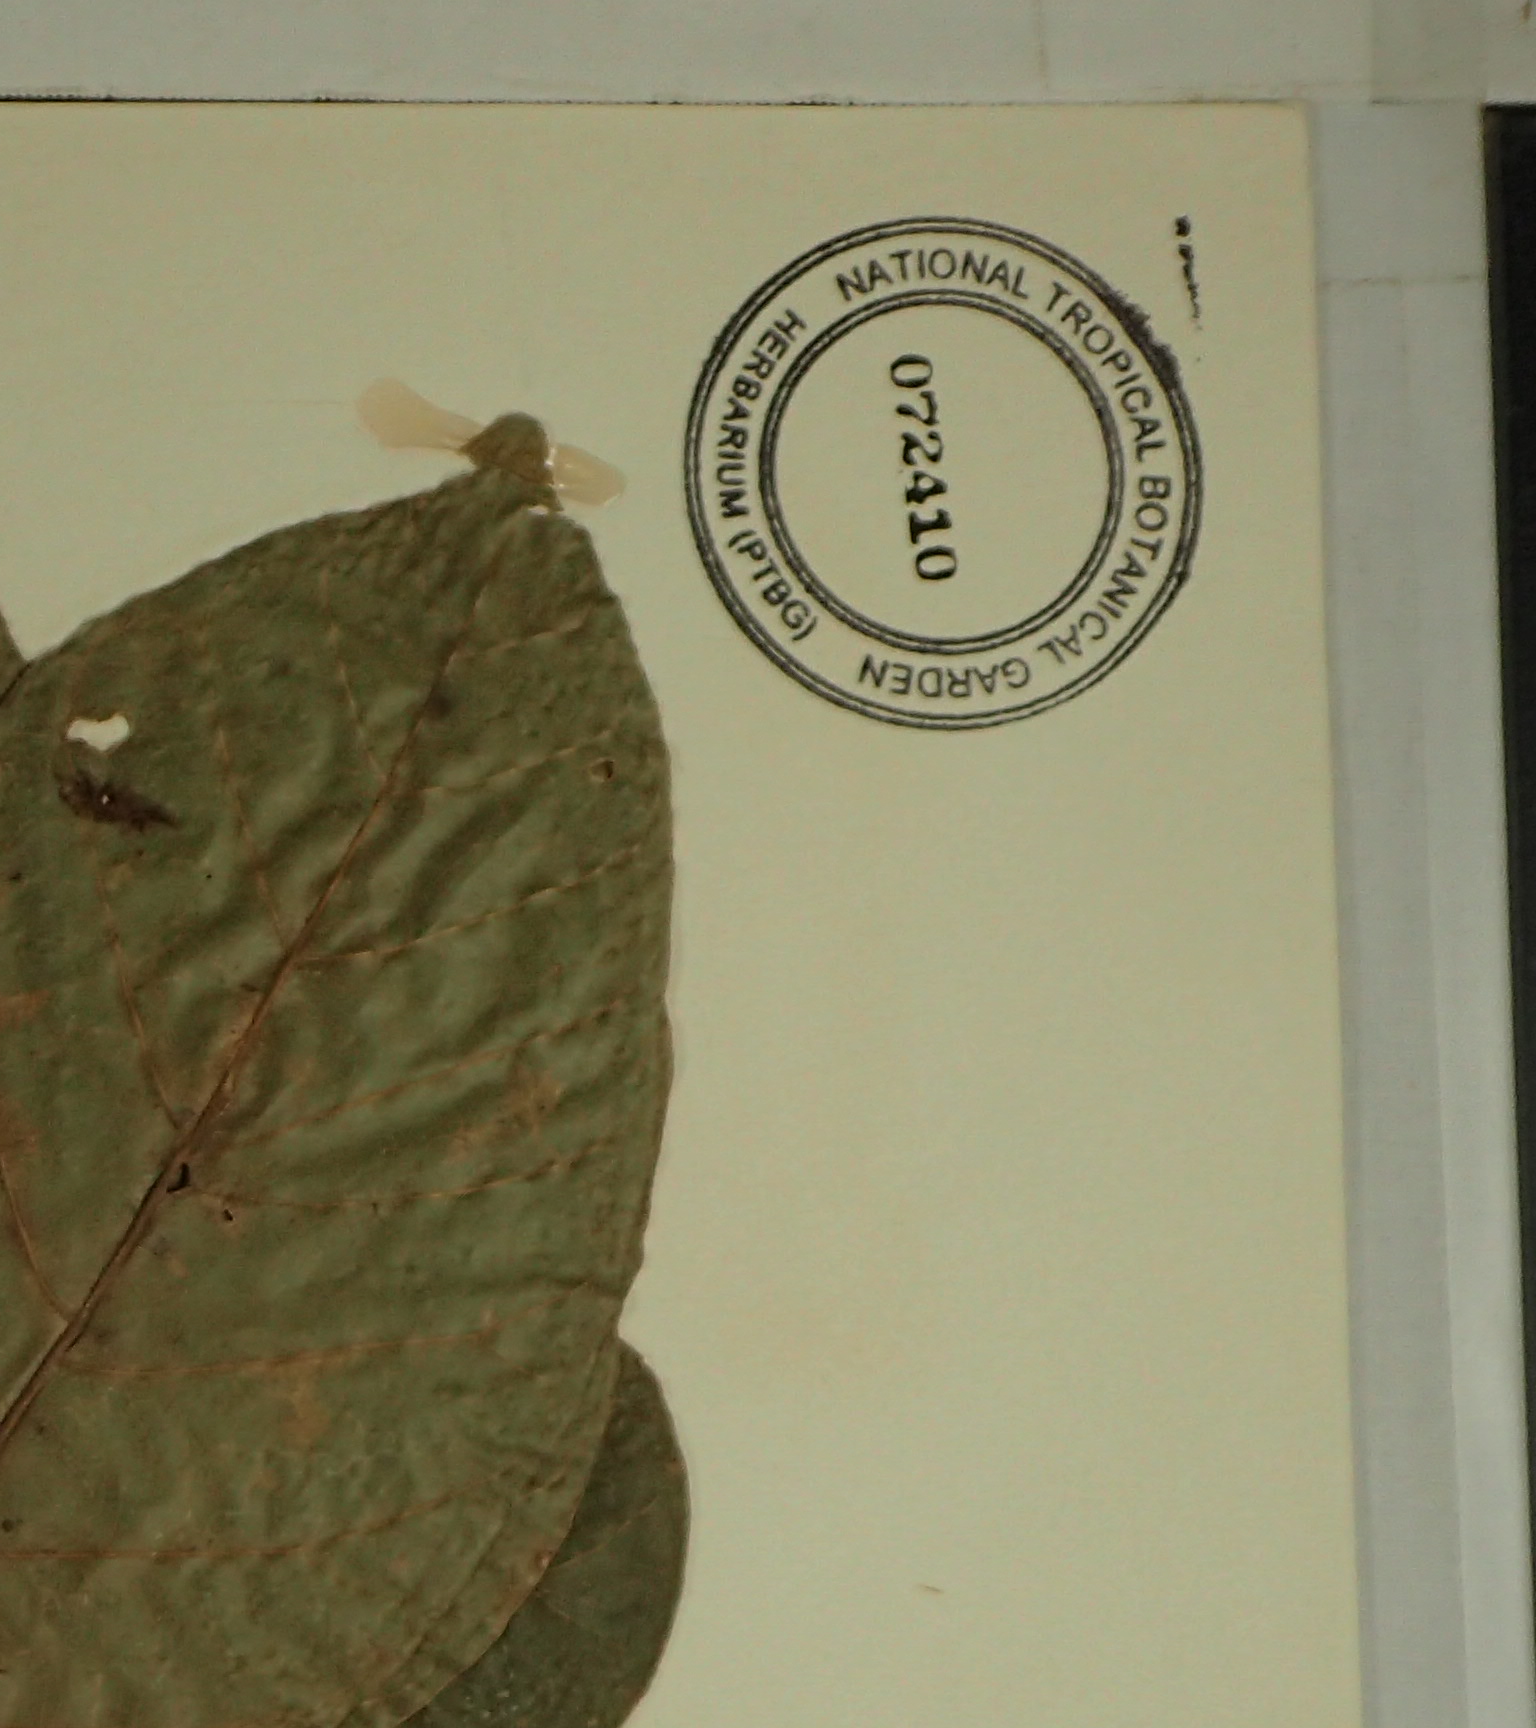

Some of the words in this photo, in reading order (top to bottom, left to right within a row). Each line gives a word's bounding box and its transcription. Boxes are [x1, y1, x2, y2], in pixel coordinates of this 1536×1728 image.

[836, 248, 1030, 301] NATIONAL
[717, 309, 807, 519] HERBARIUM
[1044, 281, 1168, 463] TROPICAL
[890, 355, 957, 582] 072410
[728, 529, 819, 642] (PTBG)
[1036, 475, 1172, 666] BOTANICAL
[858, 653, 1032, 699] GARDEN
